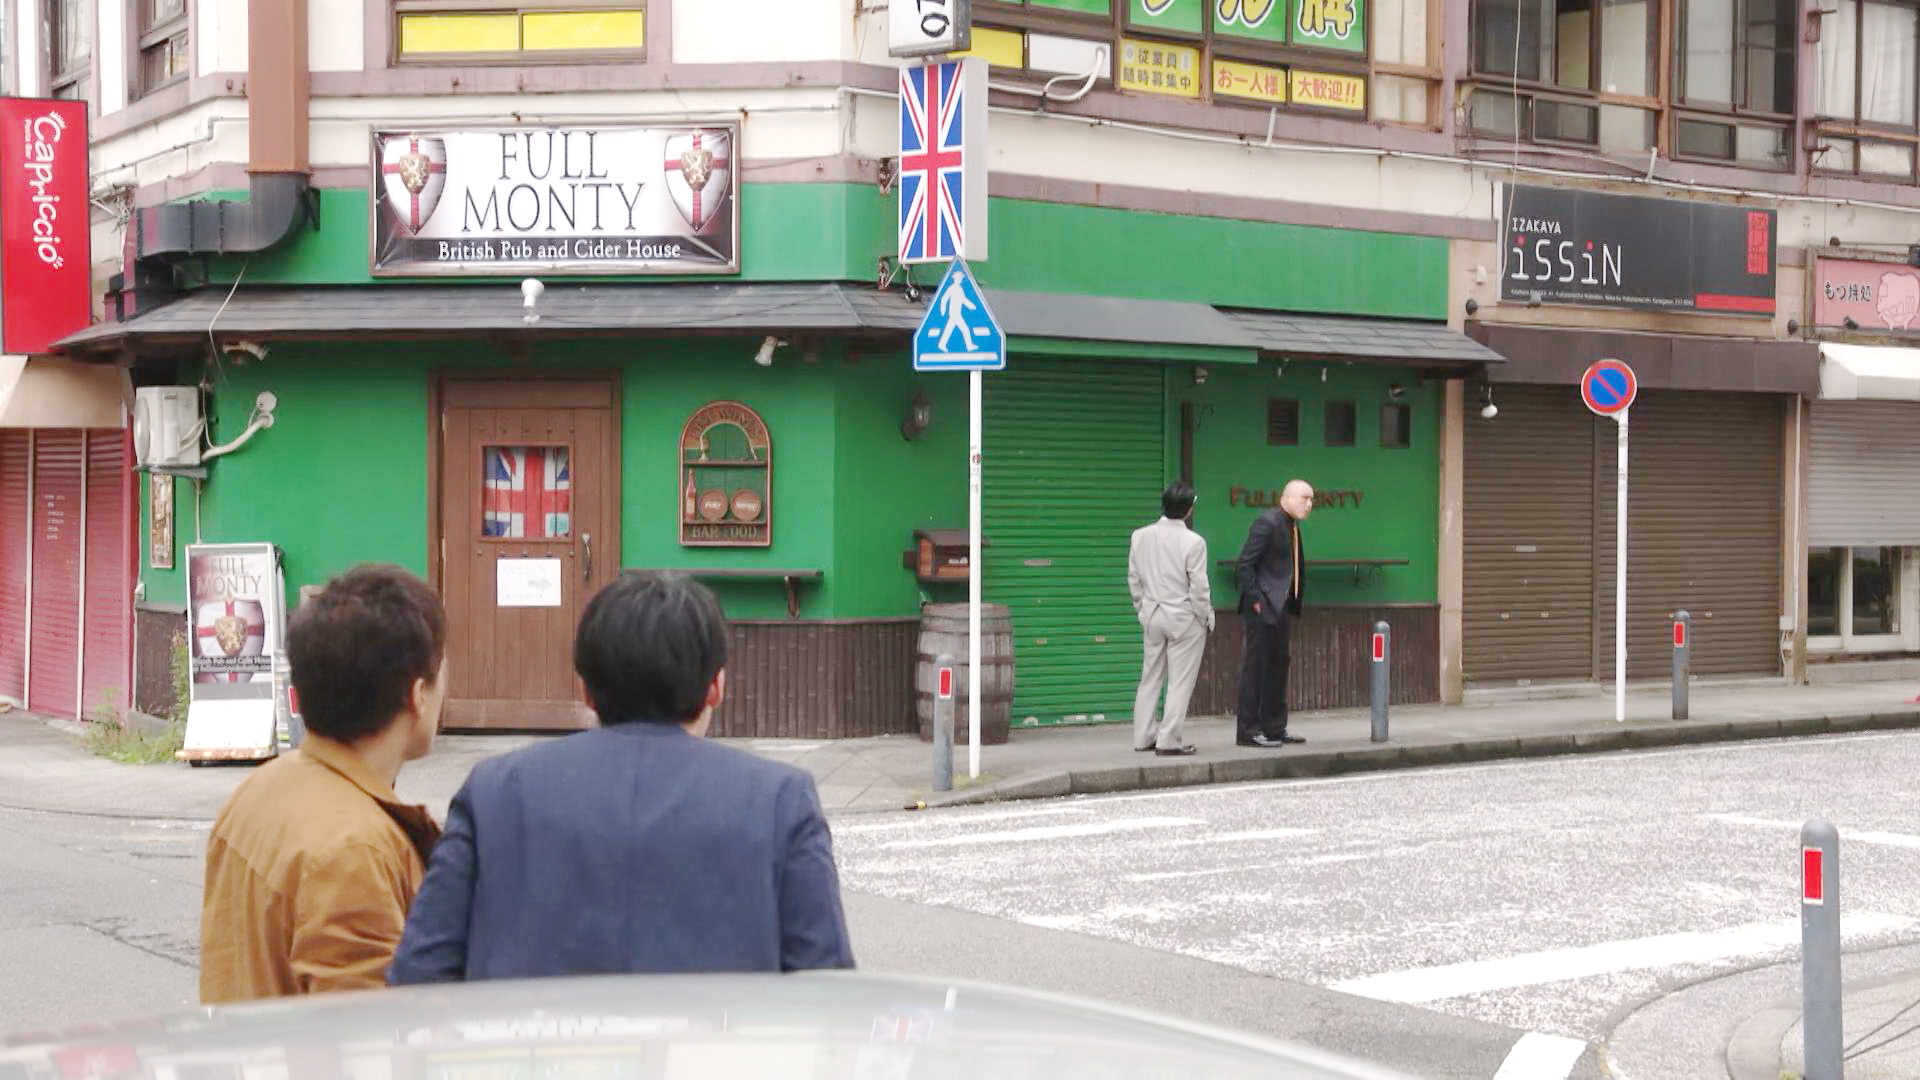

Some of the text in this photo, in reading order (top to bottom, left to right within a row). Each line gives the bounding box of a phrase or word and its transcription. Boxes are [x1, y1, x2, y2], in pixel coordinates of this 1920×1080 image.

[1217, 67, 1279, 97] お一人様
[498, 131, 609, 180] FULL
[24, 116, 62, 264] Capriccio
[461, 183, 645, 232] MONTY
[1512, 216, 1561, 235] IZAKAYA
[437, 239, 681, 261] British Pub and Cider House
